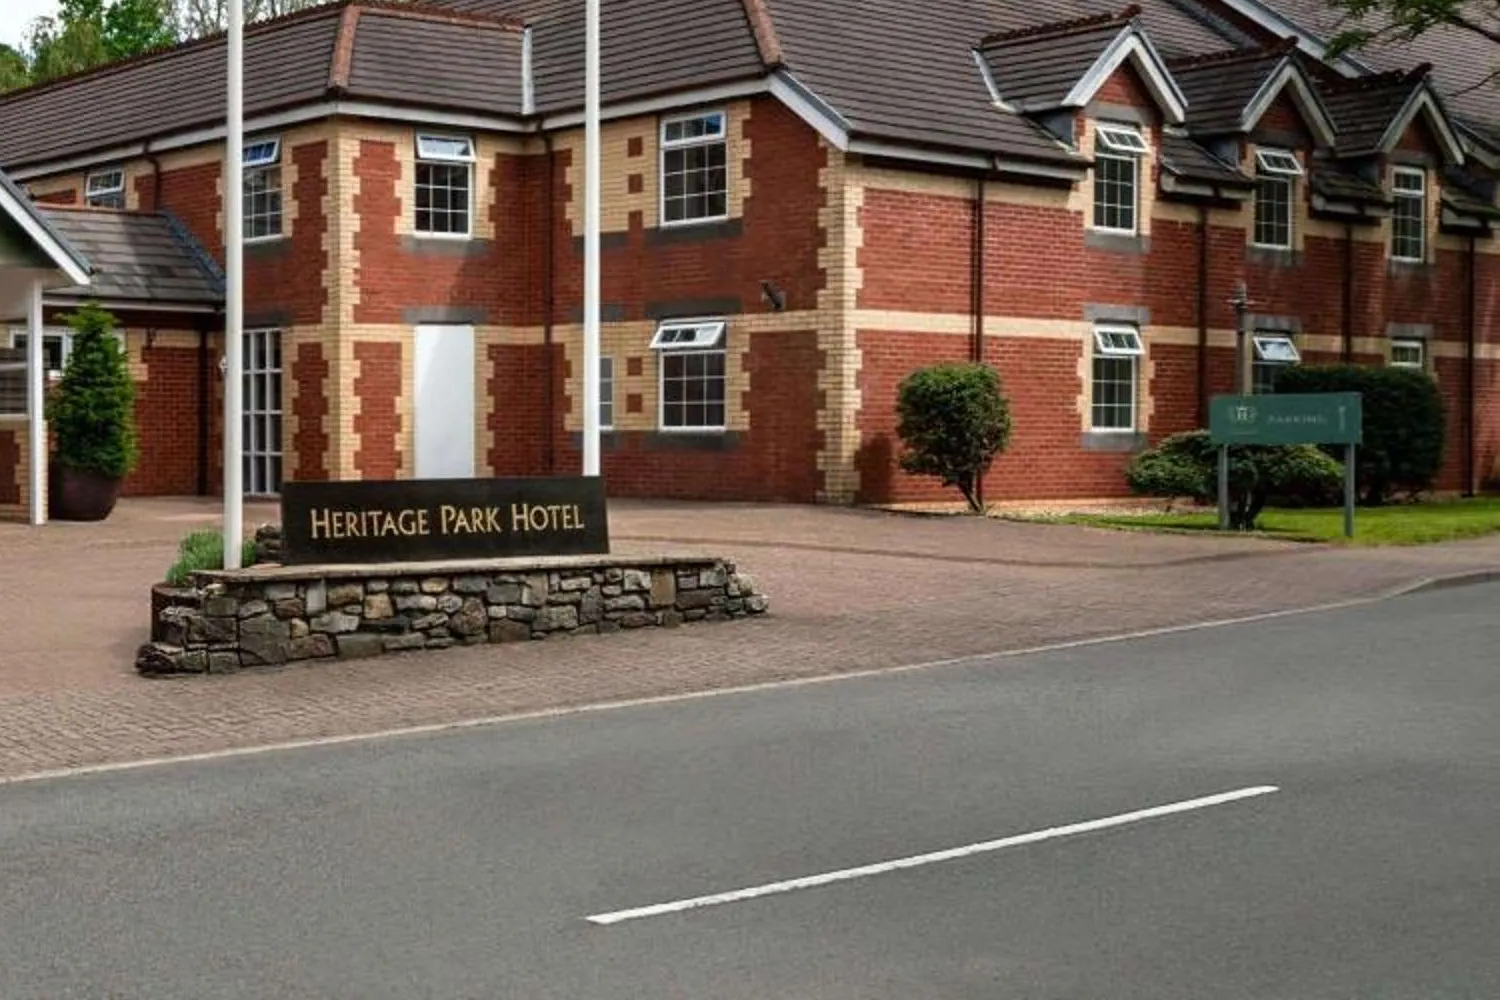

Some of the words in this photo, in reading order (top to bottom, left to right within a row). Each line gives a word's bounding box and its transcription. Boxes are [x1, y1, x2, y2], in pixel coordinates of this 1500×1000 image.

[310, 508, 431, 539] HERITAGE
[440, 505, 502, 535] PARK
[511, 503, 585, 532] HOTEL
